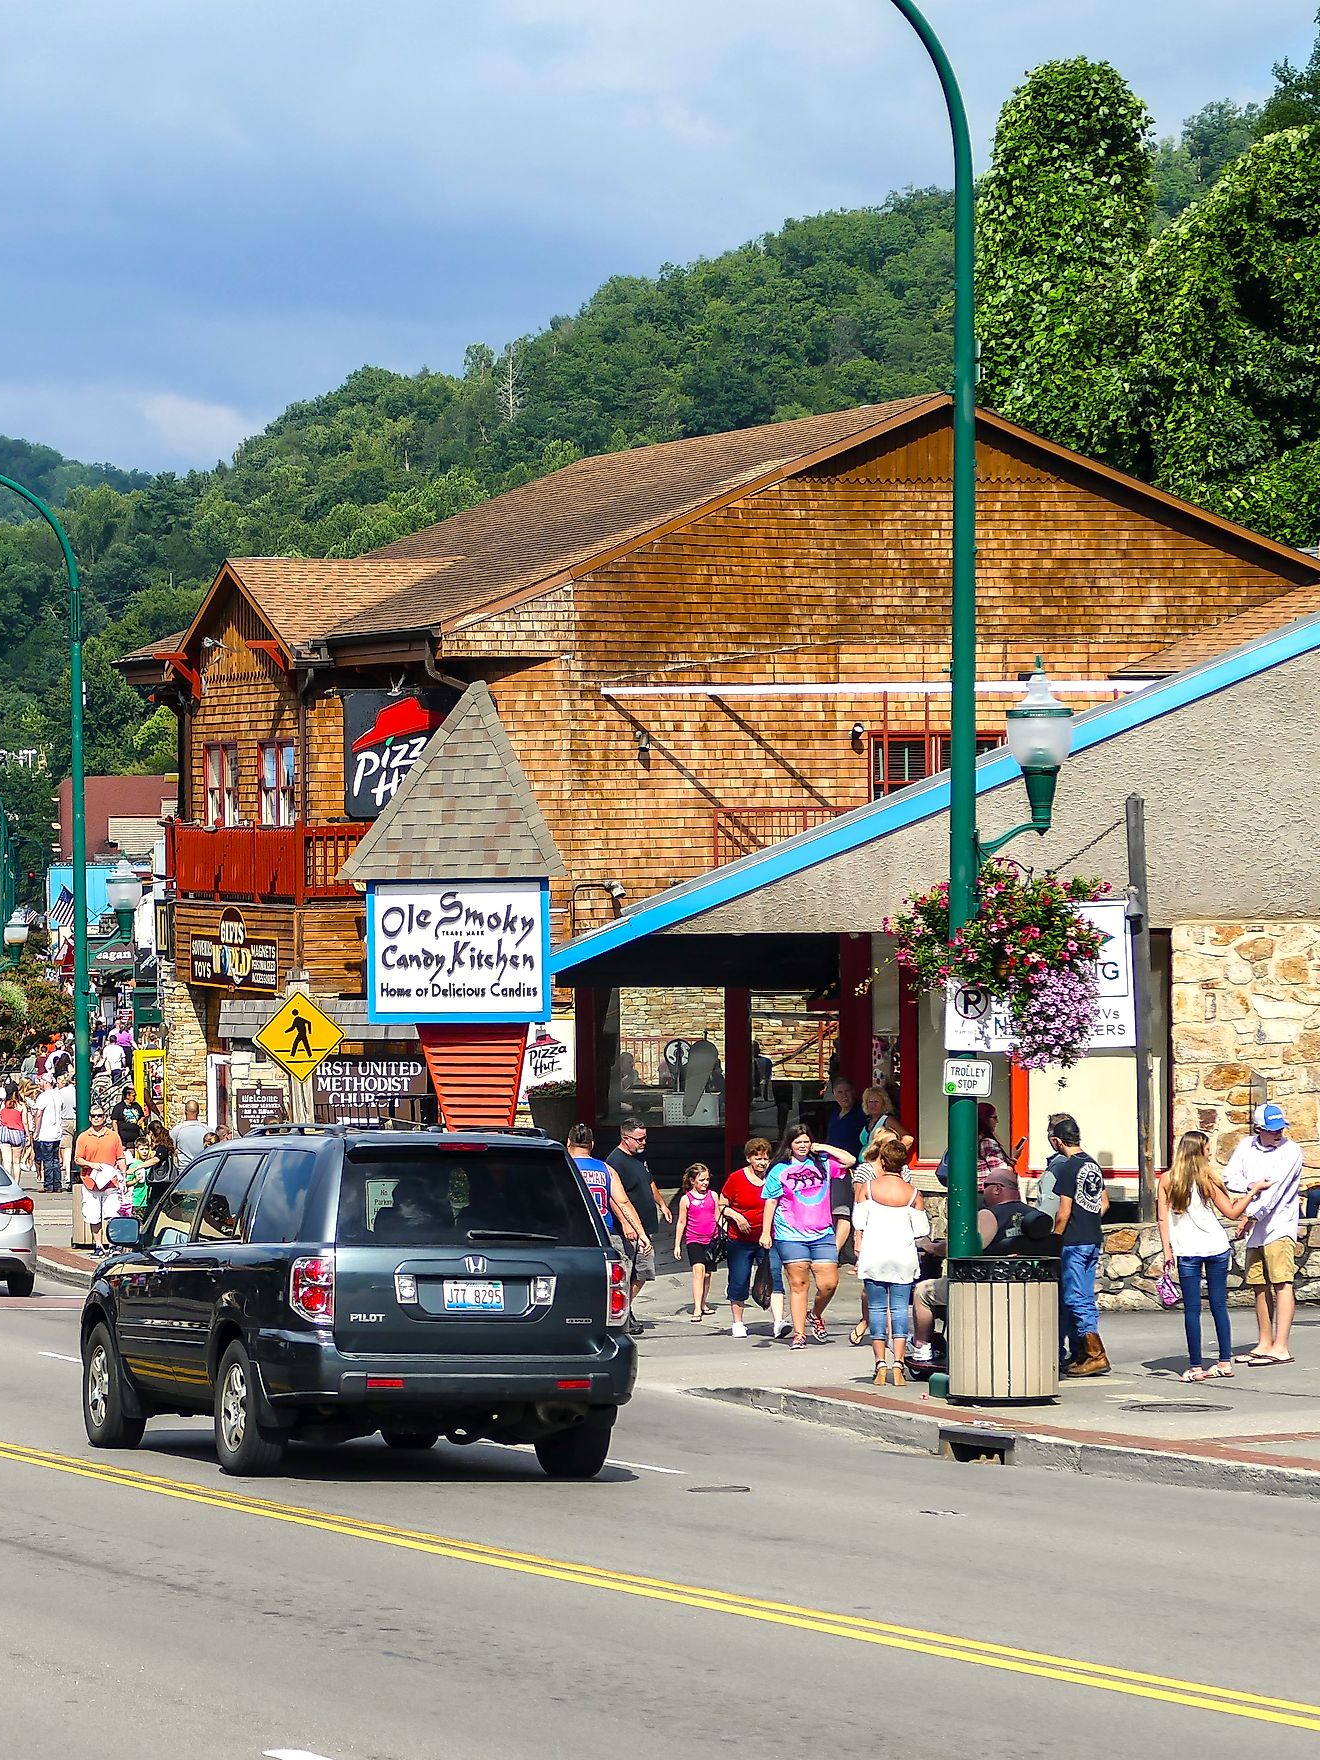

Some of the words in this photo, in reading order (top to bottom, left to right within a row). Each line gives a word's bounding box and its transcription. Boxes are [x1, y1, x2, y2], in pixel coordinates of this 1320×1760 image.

[382, 903, 432, 939] Ole
[435, 892, 535, 948] Smoky
[220, 921, 245, 944] GIFTS
[251, 945, 276, 959] MAGNETS
[382, 945, 447, 984] Candy
[447, 938, 535, 982] Kitchen
[194, 961, 211, 978] TOYS
[381, 983, 412, 998] Home
[432, 983, 486, 998] Delicious
[490, 983, 538, 998] Candies
[528, 1046, 567, 1067] Pizza
[358, 1061, 422, 1076] UNITED
[533, 1058, 560, 1077] Hut
[951, 1066, 986, 1077] TROLLEY
[317, 1077, 411, 1092] METHODIST
[958, 1079, 978, 1089] STOP
[241, 1095, 279, 1103] Welcome
[448, 1288, 467, 1304] J77
[474, 1289, 502, 1304] 8295
[350, 1313, 385, 1322] PILOT
